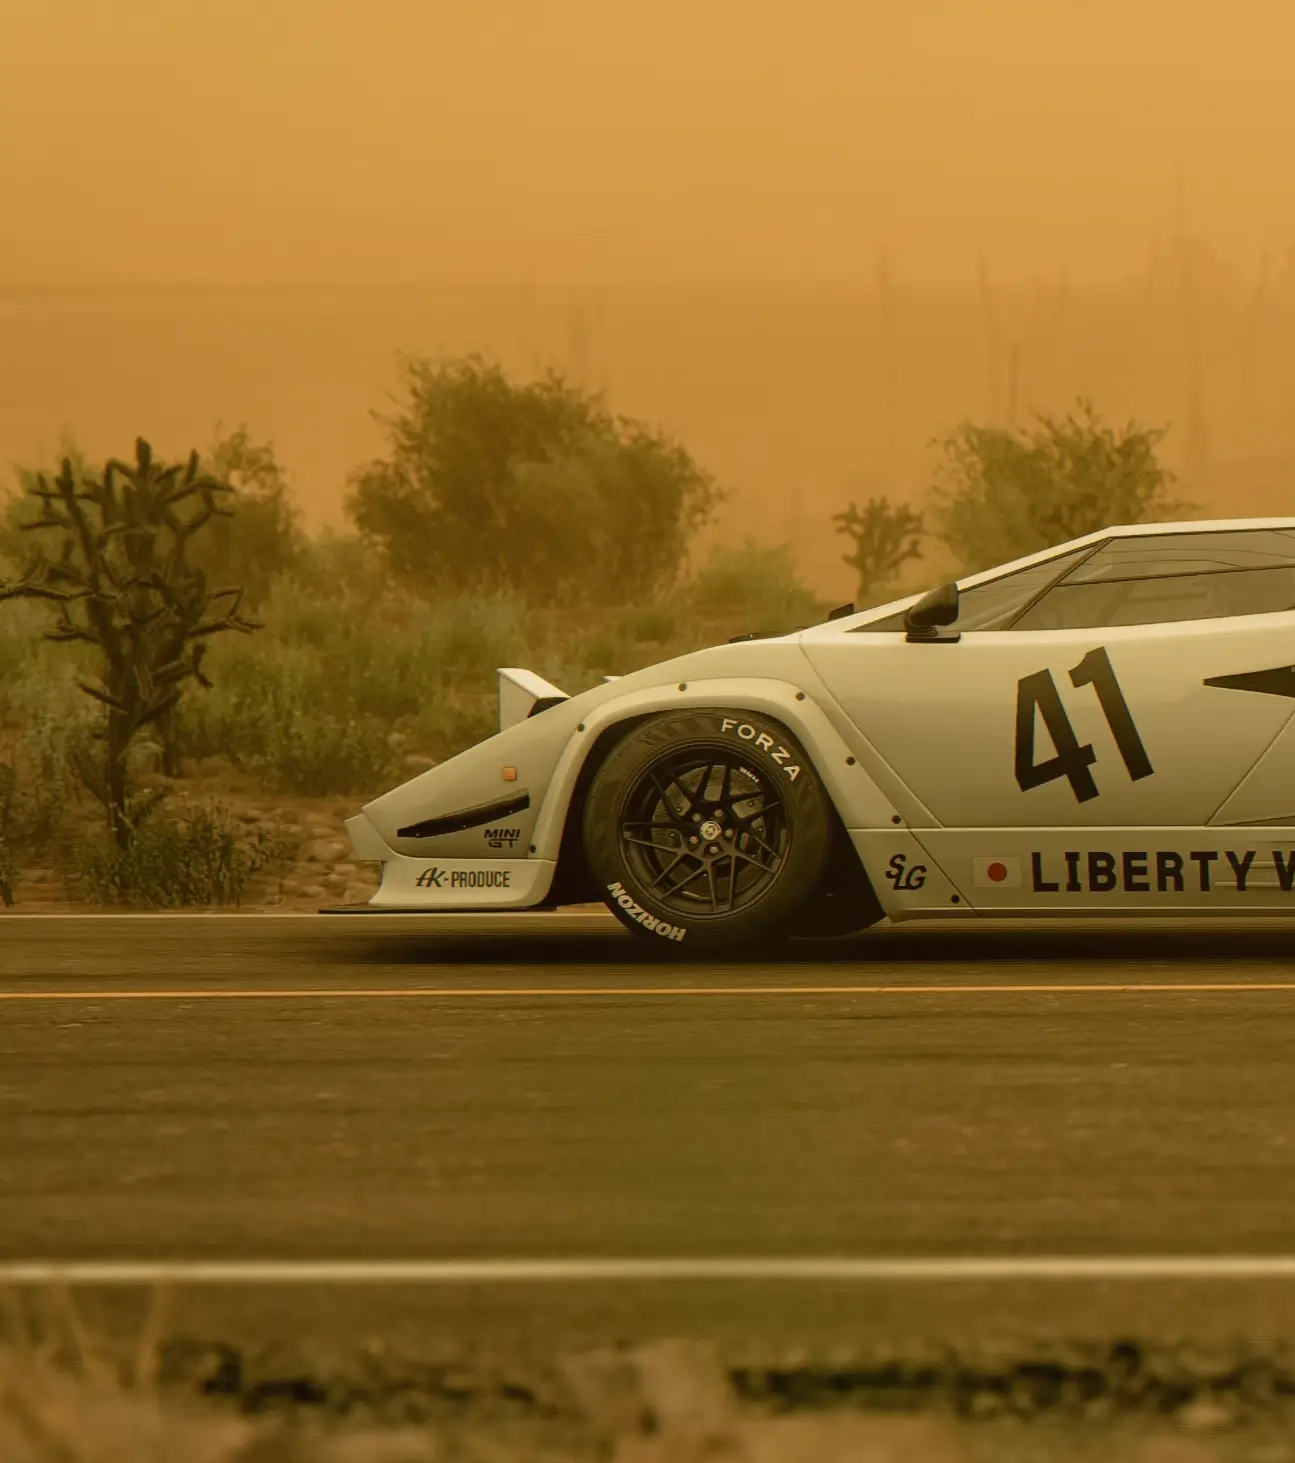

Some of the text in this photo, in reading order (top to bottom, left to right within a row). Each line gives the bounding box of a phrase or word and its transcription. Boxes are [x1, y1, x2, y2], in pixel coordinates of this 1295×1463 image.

[721, 718, 800, 781] FORZA
[1014, 646, 1155, 804] 41
[484, 829, 521, 838] MINI
[488, 838, 519, 848] GT
[1031, 851, 1257, 892] LIBERTY
[606, 881, 687, 942] HORIZON
